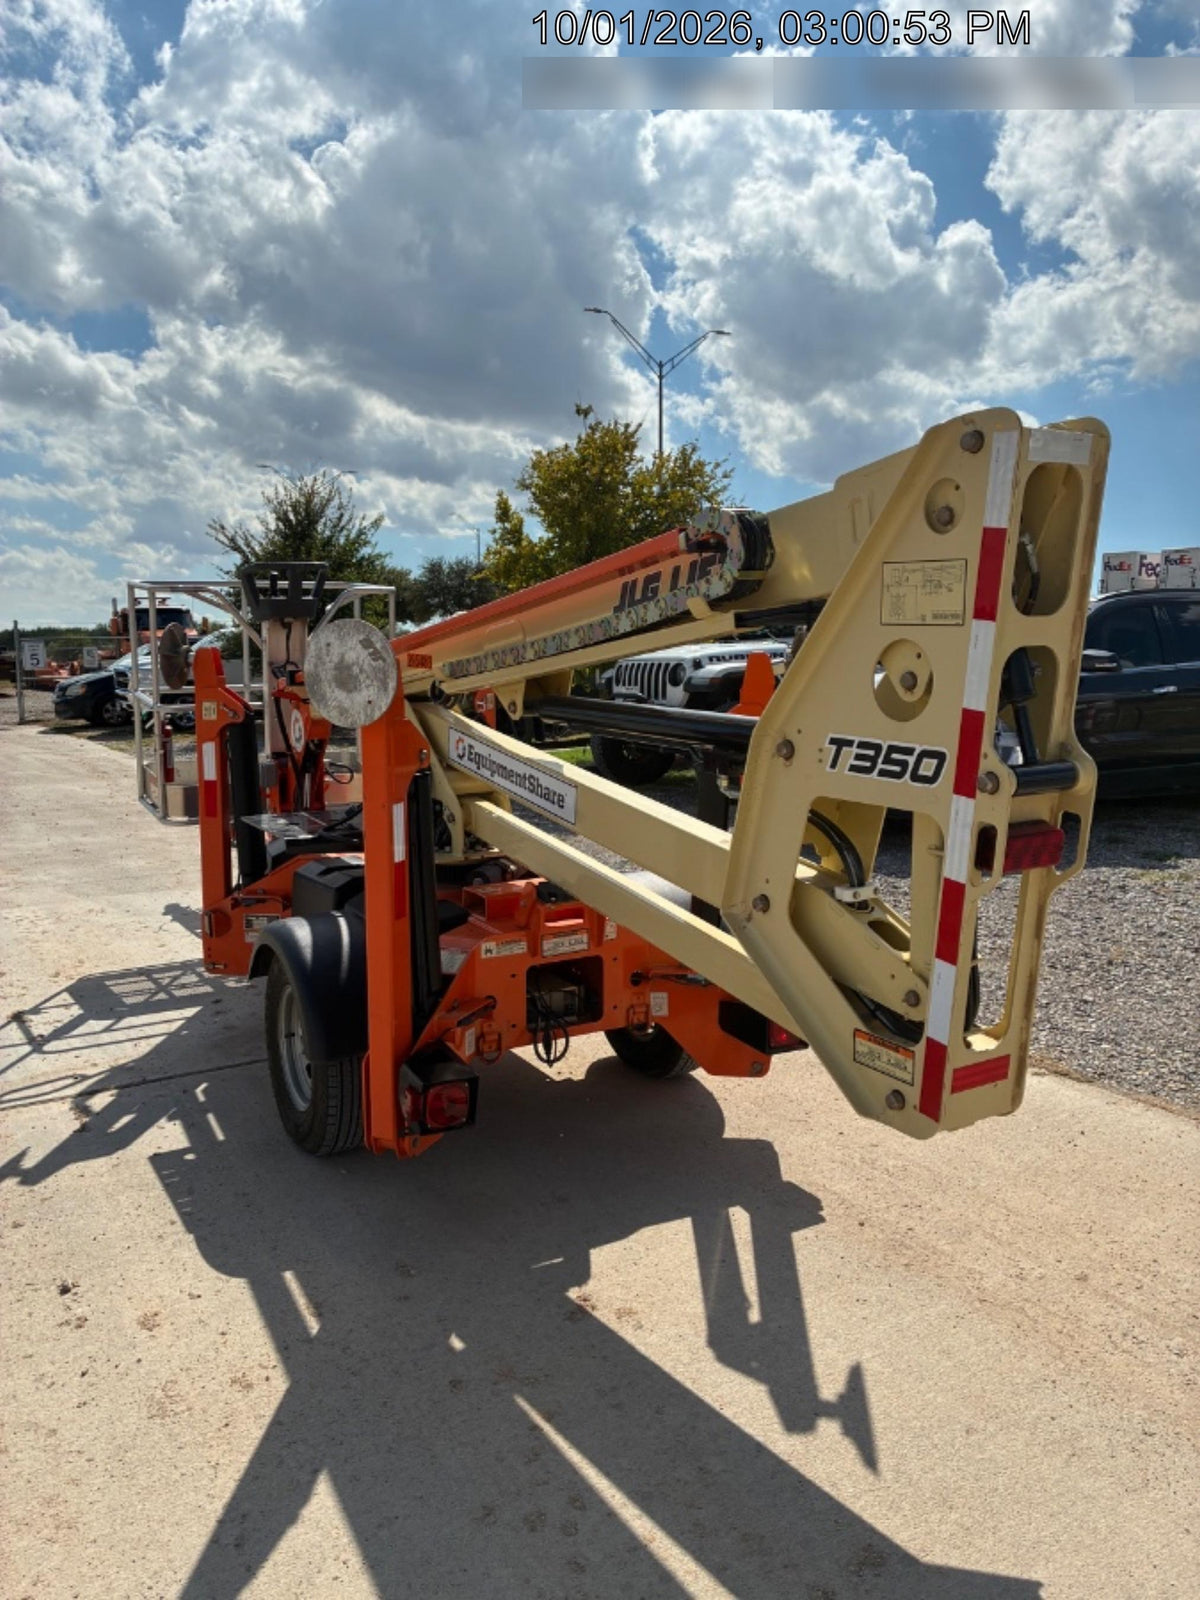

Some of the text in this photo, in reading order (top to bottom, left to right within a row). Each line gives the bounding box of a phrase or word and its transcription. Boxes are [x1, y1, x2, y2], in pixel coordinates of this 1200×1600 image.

[613, 570, 662, 614] JLG
[30, 653, 40, 667] 5
[467, 743, 565, 809] EquipmentShare
[827, 735, 947, 786] T350
